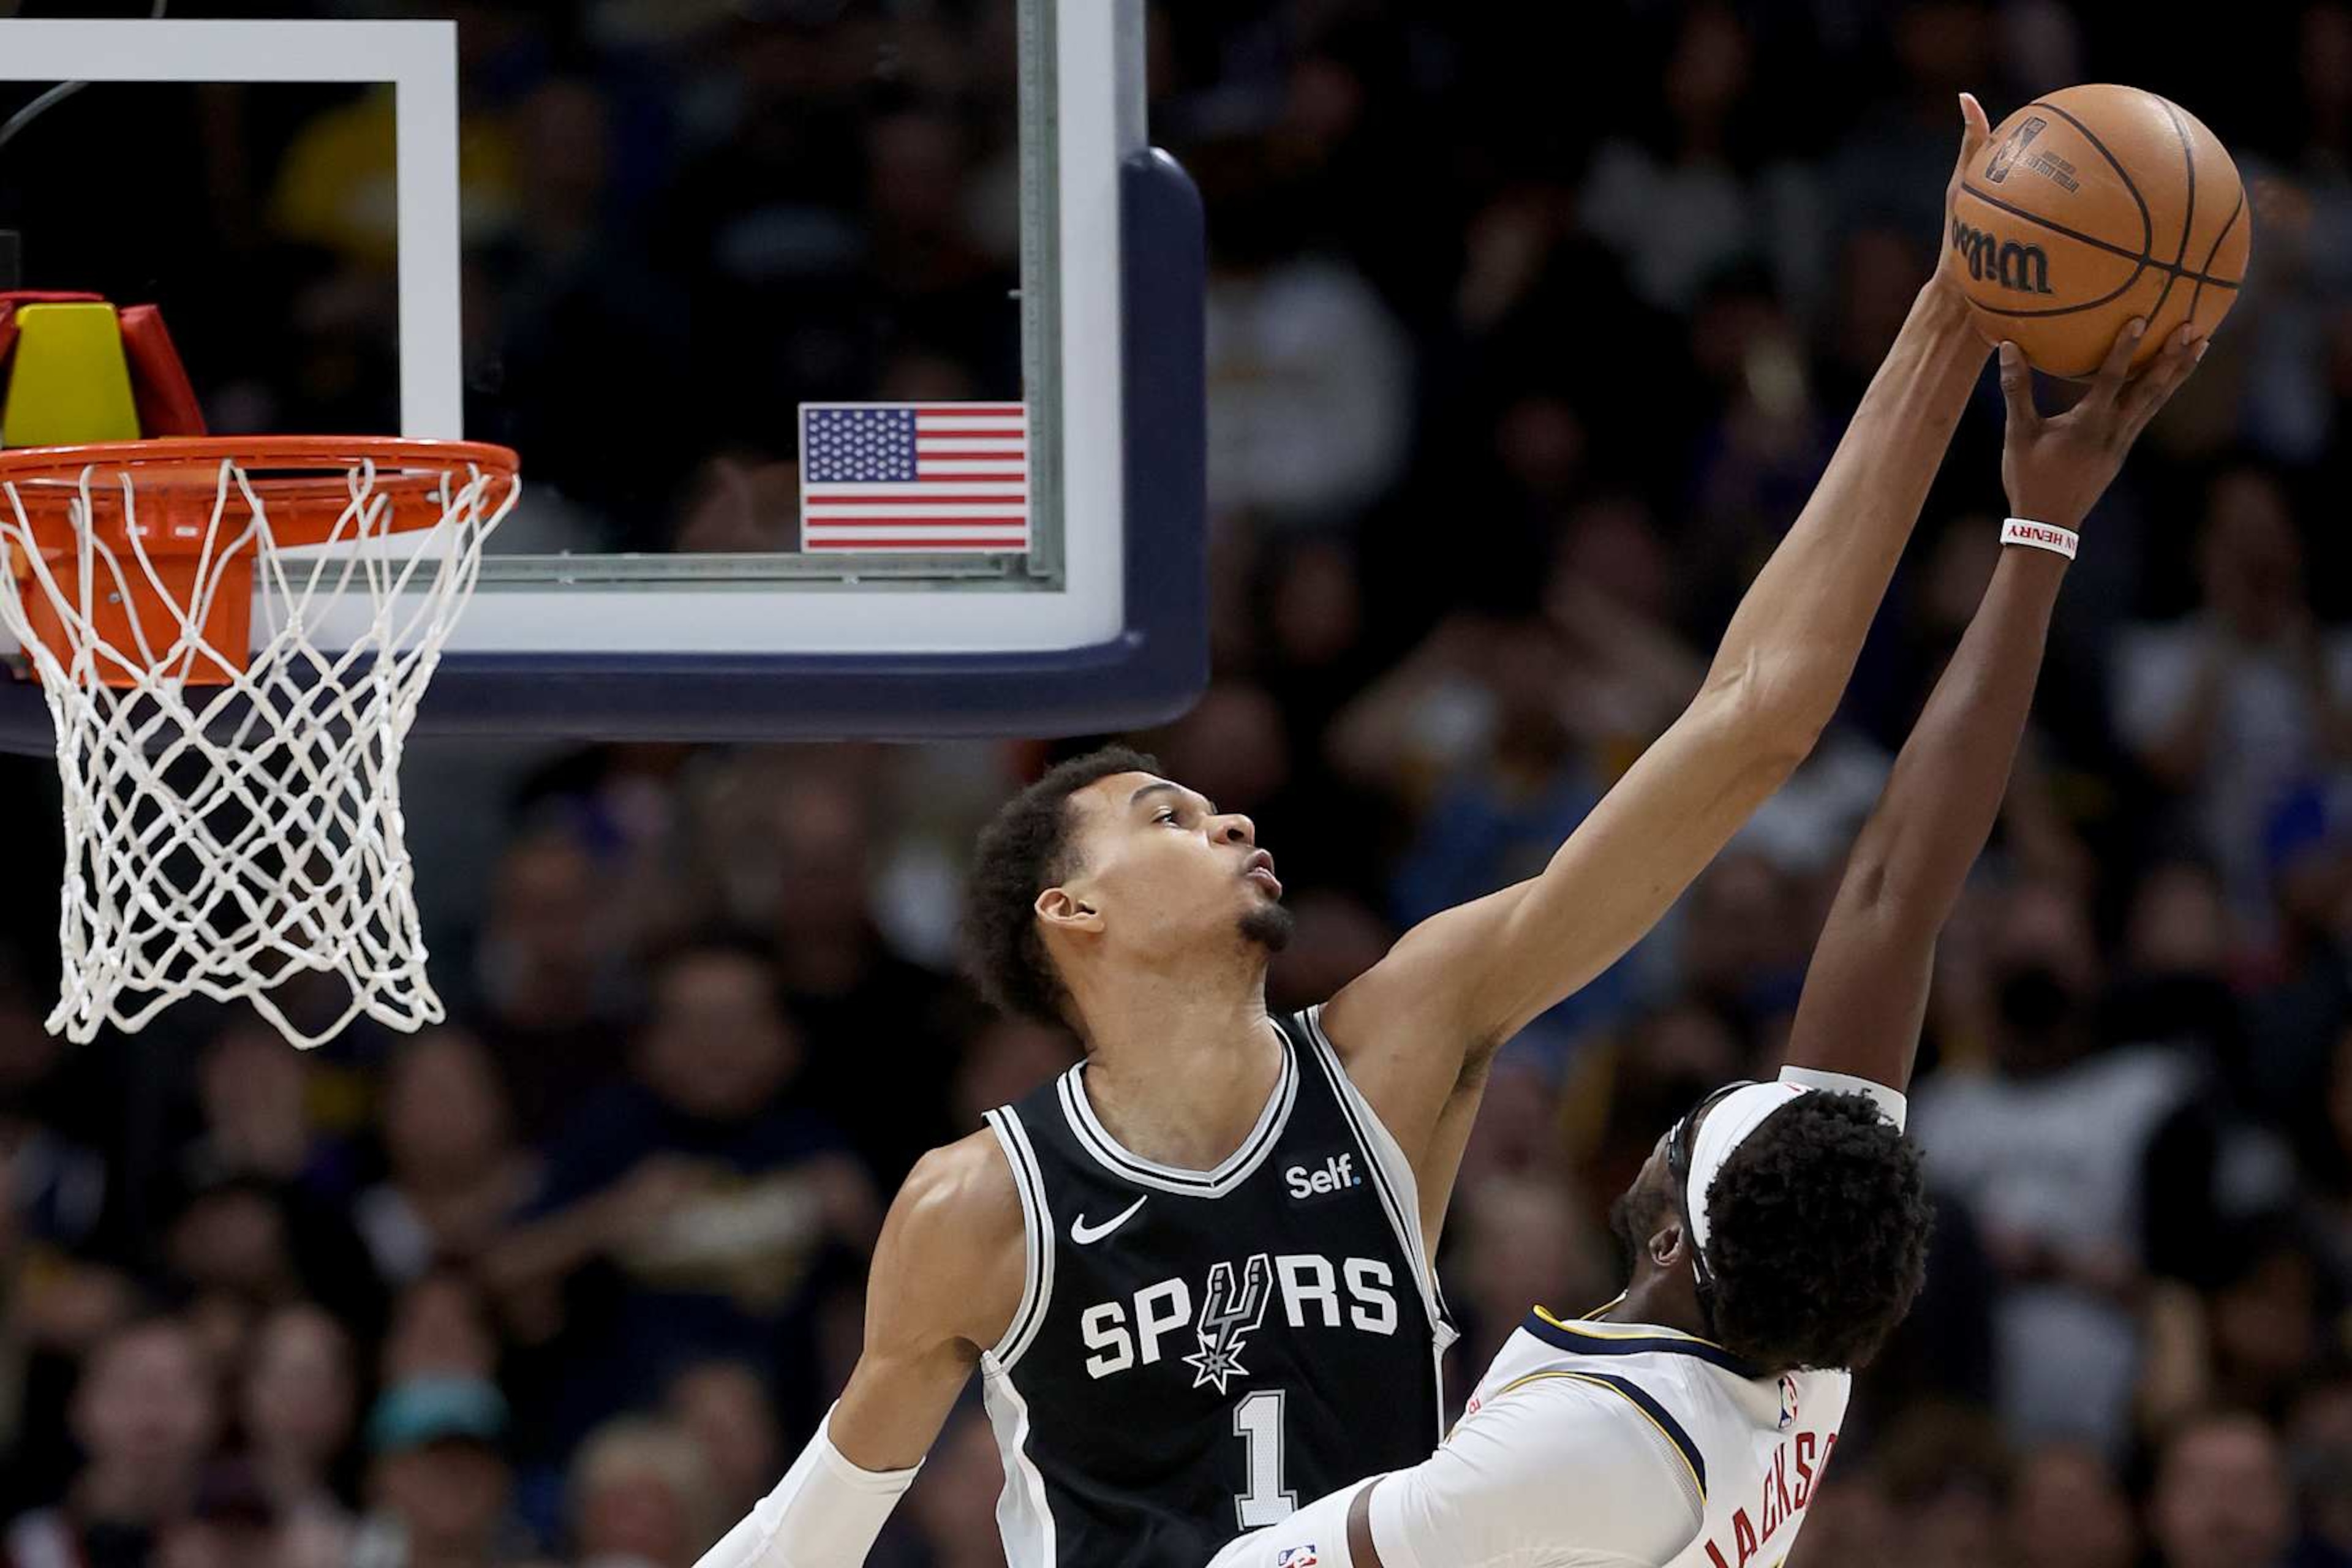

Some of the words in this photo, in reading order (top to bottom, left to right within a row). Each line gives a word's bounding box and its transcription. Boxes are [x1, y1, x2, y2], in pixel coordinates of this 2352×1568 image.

[1951, 221, 2053, 295] Wilso
[2008, 525, 2063, 546] HENRY
[1081, 1253, 1398, 1395] SPURS
[1233, 1389, 1298, 1531] 1
